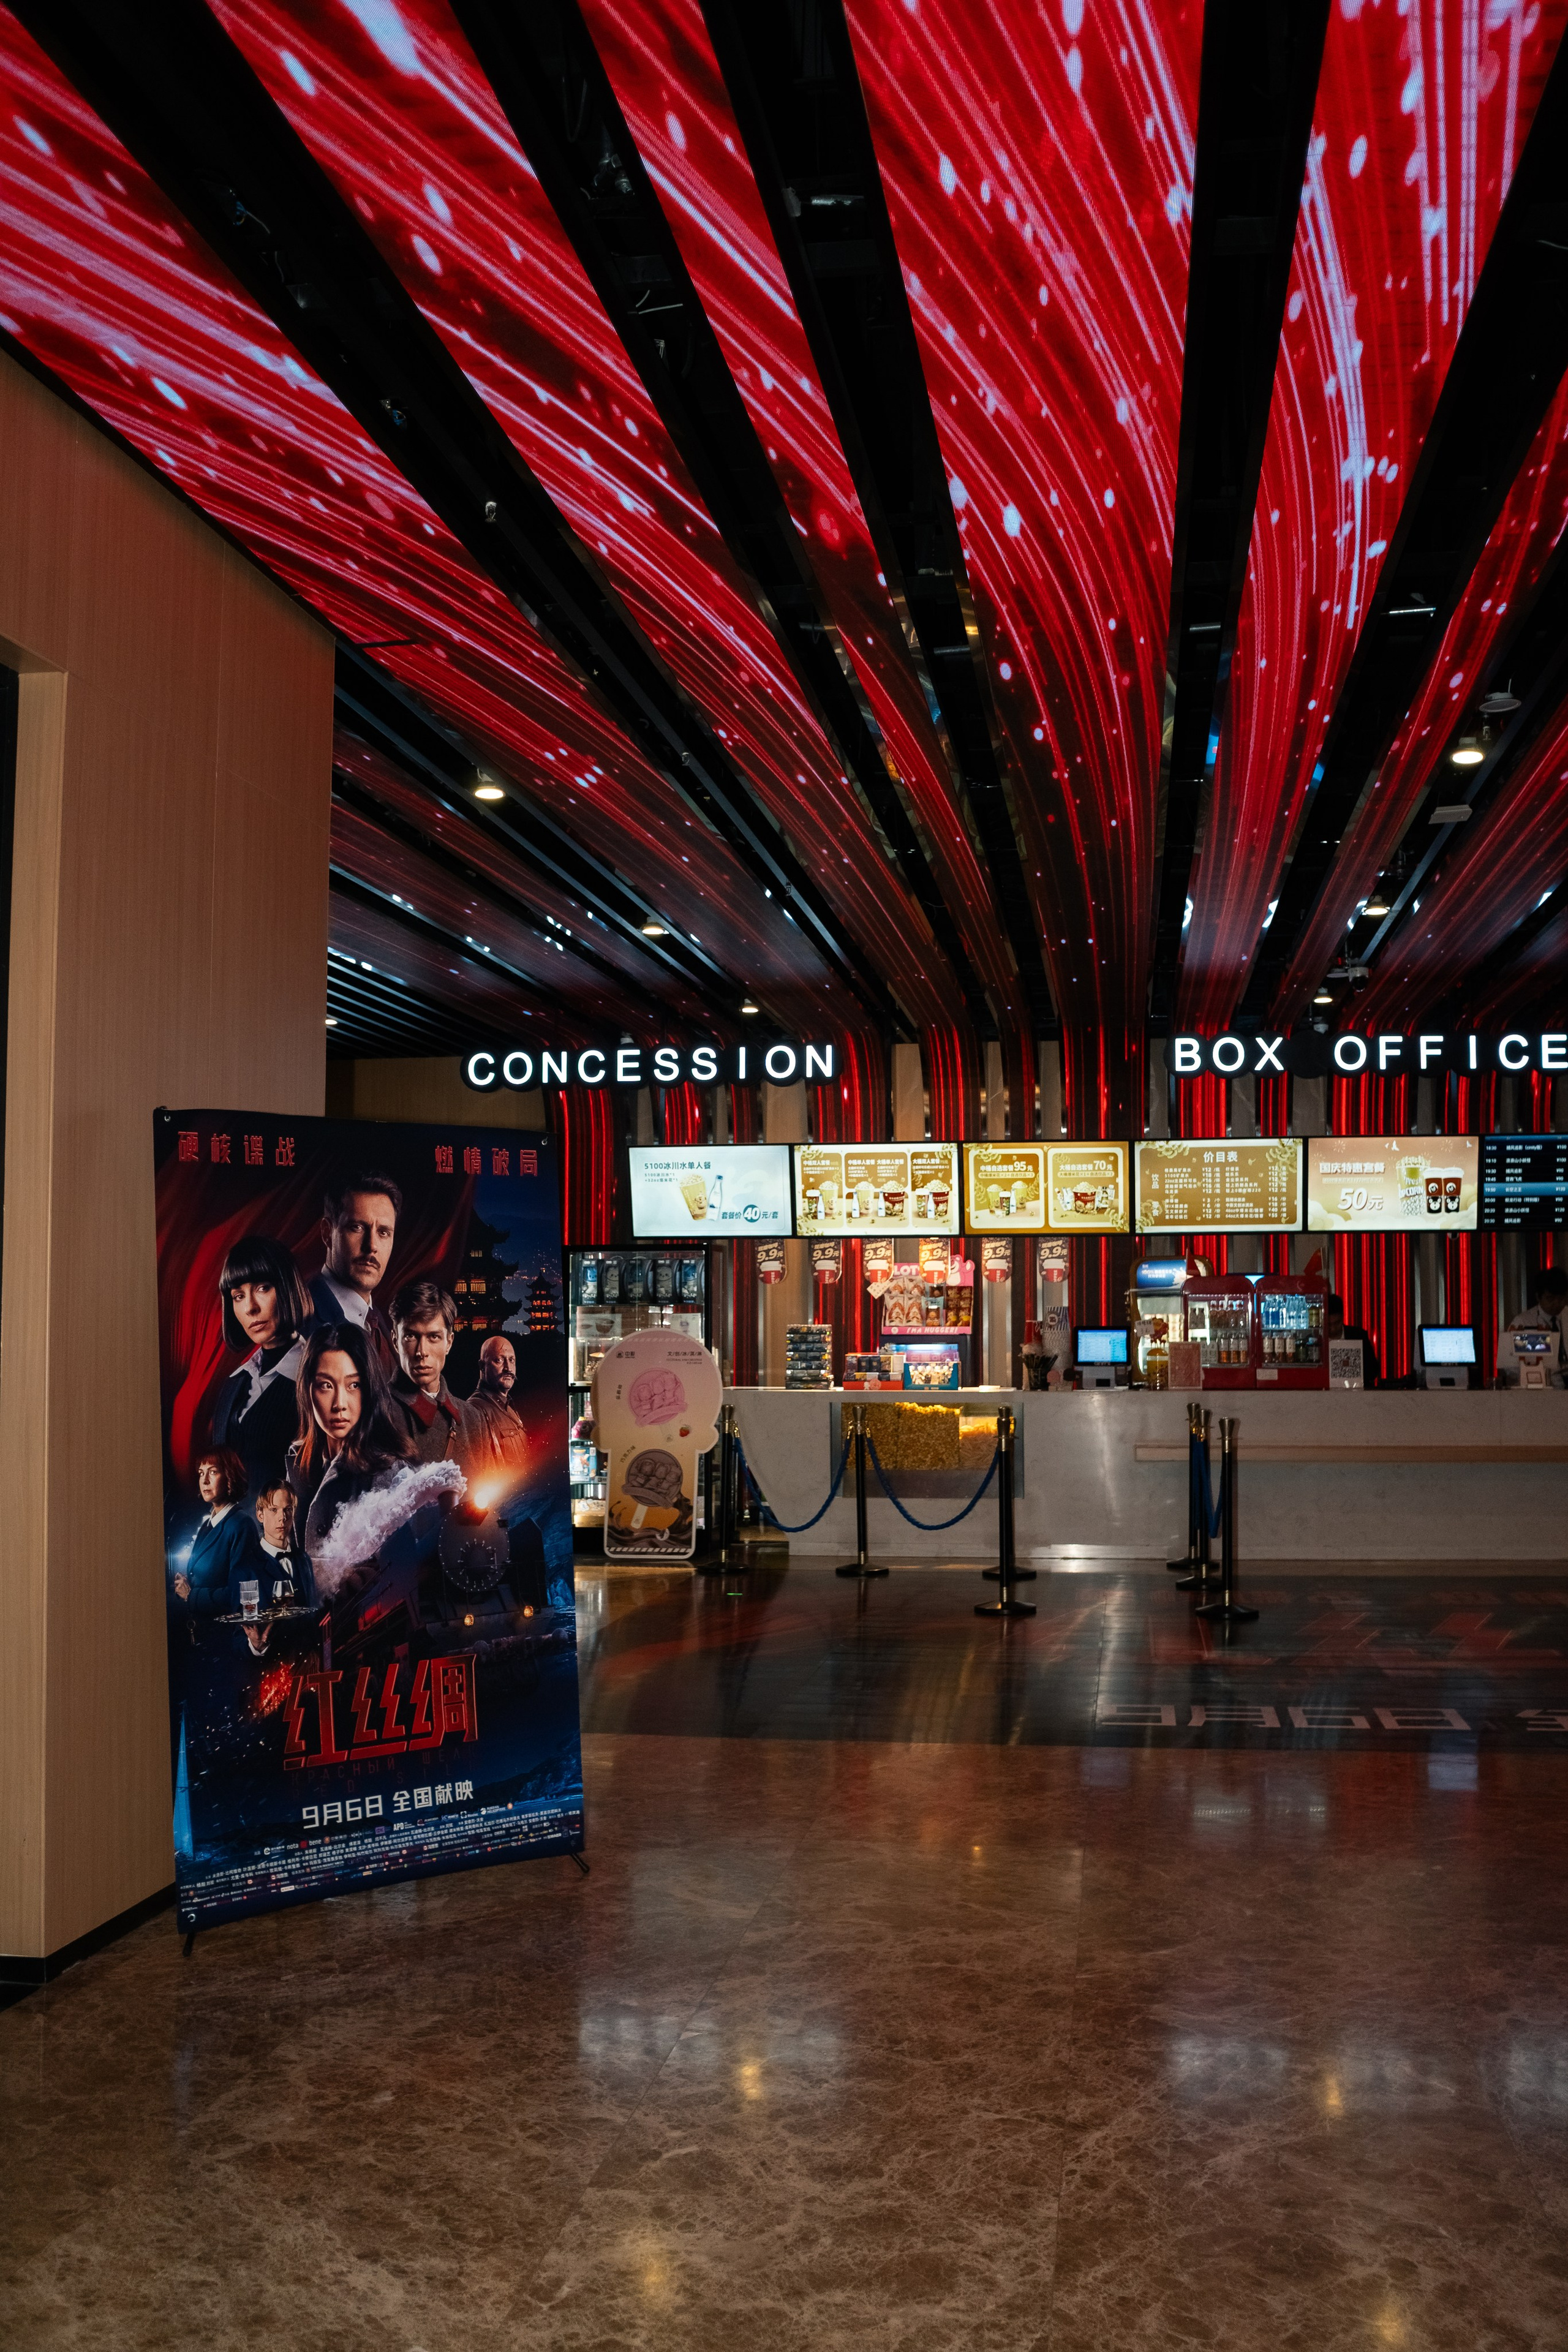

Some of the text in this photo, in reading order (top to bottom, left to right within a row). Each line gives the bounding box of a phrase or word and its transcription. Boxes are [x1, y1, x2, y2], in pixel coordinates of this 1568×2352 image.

[1175, 1033, 1568, 1072] BOX OFFICE
[467, 1044, 833, 1086] CONCESSION
[178, 1131, 295, 1167] 硬核谍战
[435, 1145, 538, 1177] 燃情破局
[1204, 1152, 1237, 1163] 价目表
[1060, 1161, 1113, 1171] 大桶自选套餐70元
[1320, 1162, 1385, 1174] 国庆特惠套餐
[1337, 1188, 1383, 1210] 50元
[757, 1248, 784, 1262] 9.9元
[812, 1248, 840, 1261] 9.9元
[864, 1247, 891, 1260] 9.9元
[921, 1248, 948, 1261] 9.9元
[984, 1246, 1011, 1260] 9.9元
[1040, 1246, 1067, 1260] 9.9元
[894, 1265, 920, 1276] LOT
[283, 1654, 478, 1771] 红丝绸
[302, 1779, 474, 1830] 9月6日 全国献映
[309, 1838, 322, 1847] bene
